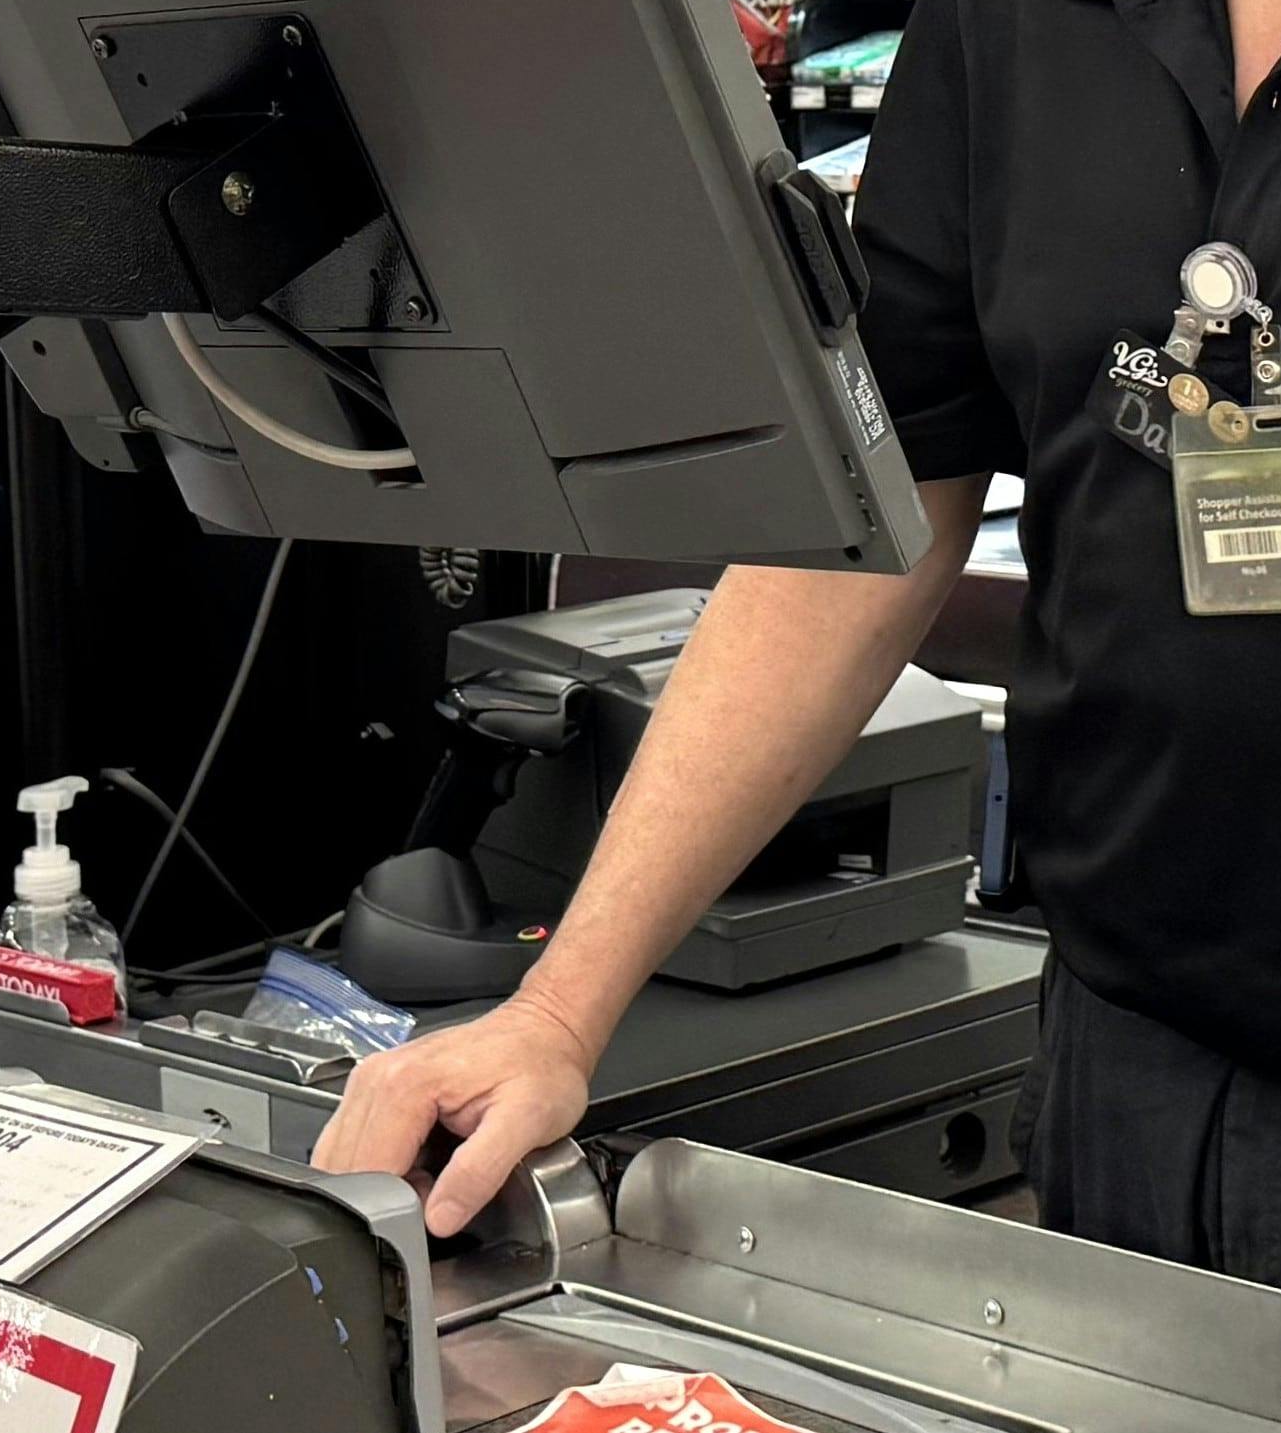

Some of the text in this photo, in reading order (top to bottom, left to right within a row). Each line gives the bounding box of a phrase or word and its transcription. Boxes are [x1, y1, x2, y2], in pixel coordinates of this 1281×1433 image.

[1197, 496, 1242, 511] Shopper
[1199, 511, 1214, 523] for
[1216, 510, 1237, 523] Self
